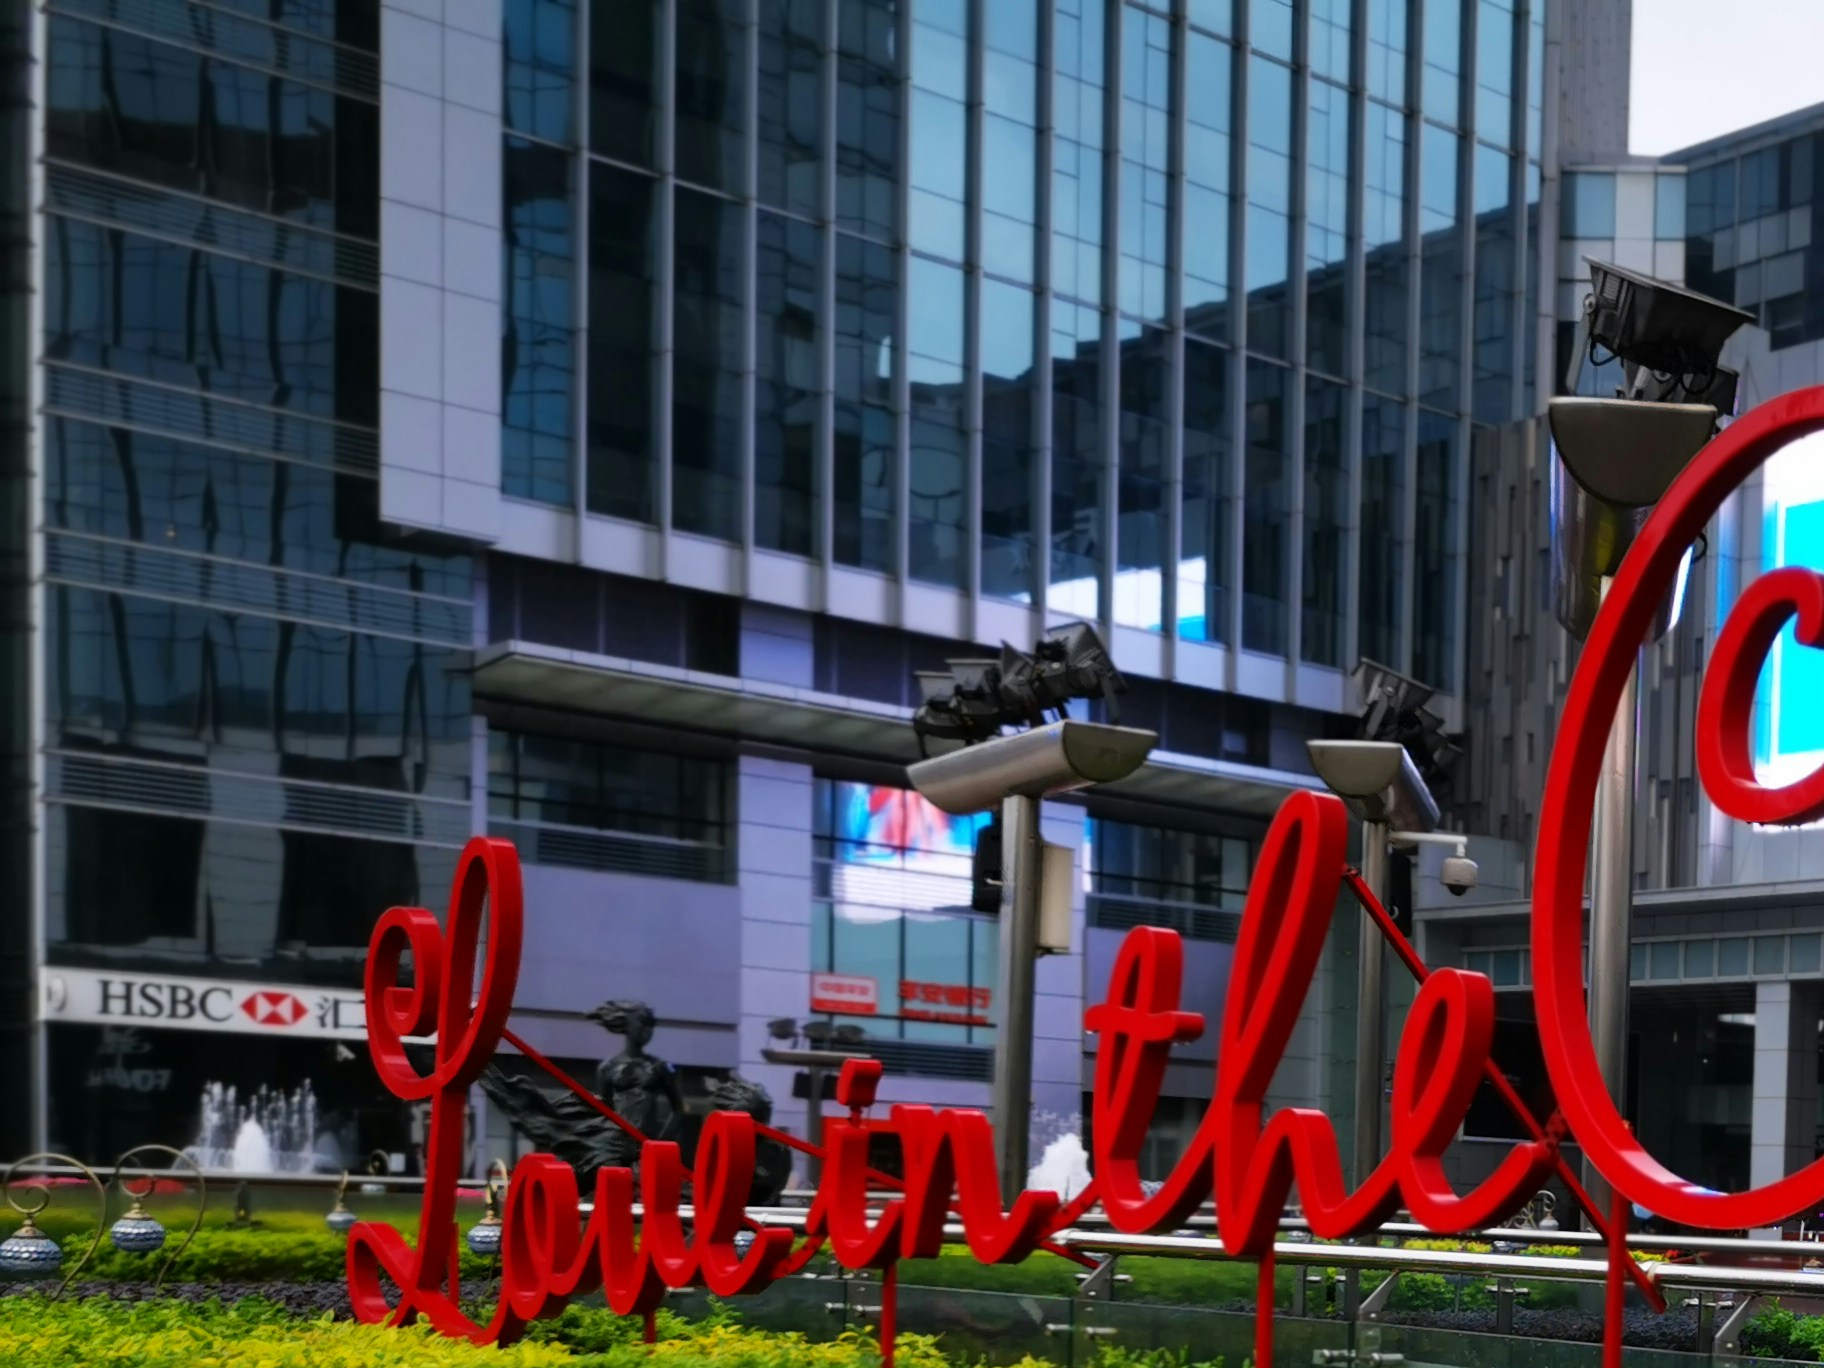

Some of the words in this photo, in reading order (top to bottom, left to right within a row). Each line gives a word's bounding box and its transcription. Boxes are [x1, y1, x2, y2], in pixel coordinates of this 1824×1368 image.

[98, 978, 234, 1024] HSBC
[346, 836, 794, 1348] Love
[808, 1058, 1060, 1270] in
[1085, 790, 1557, 1257] the
